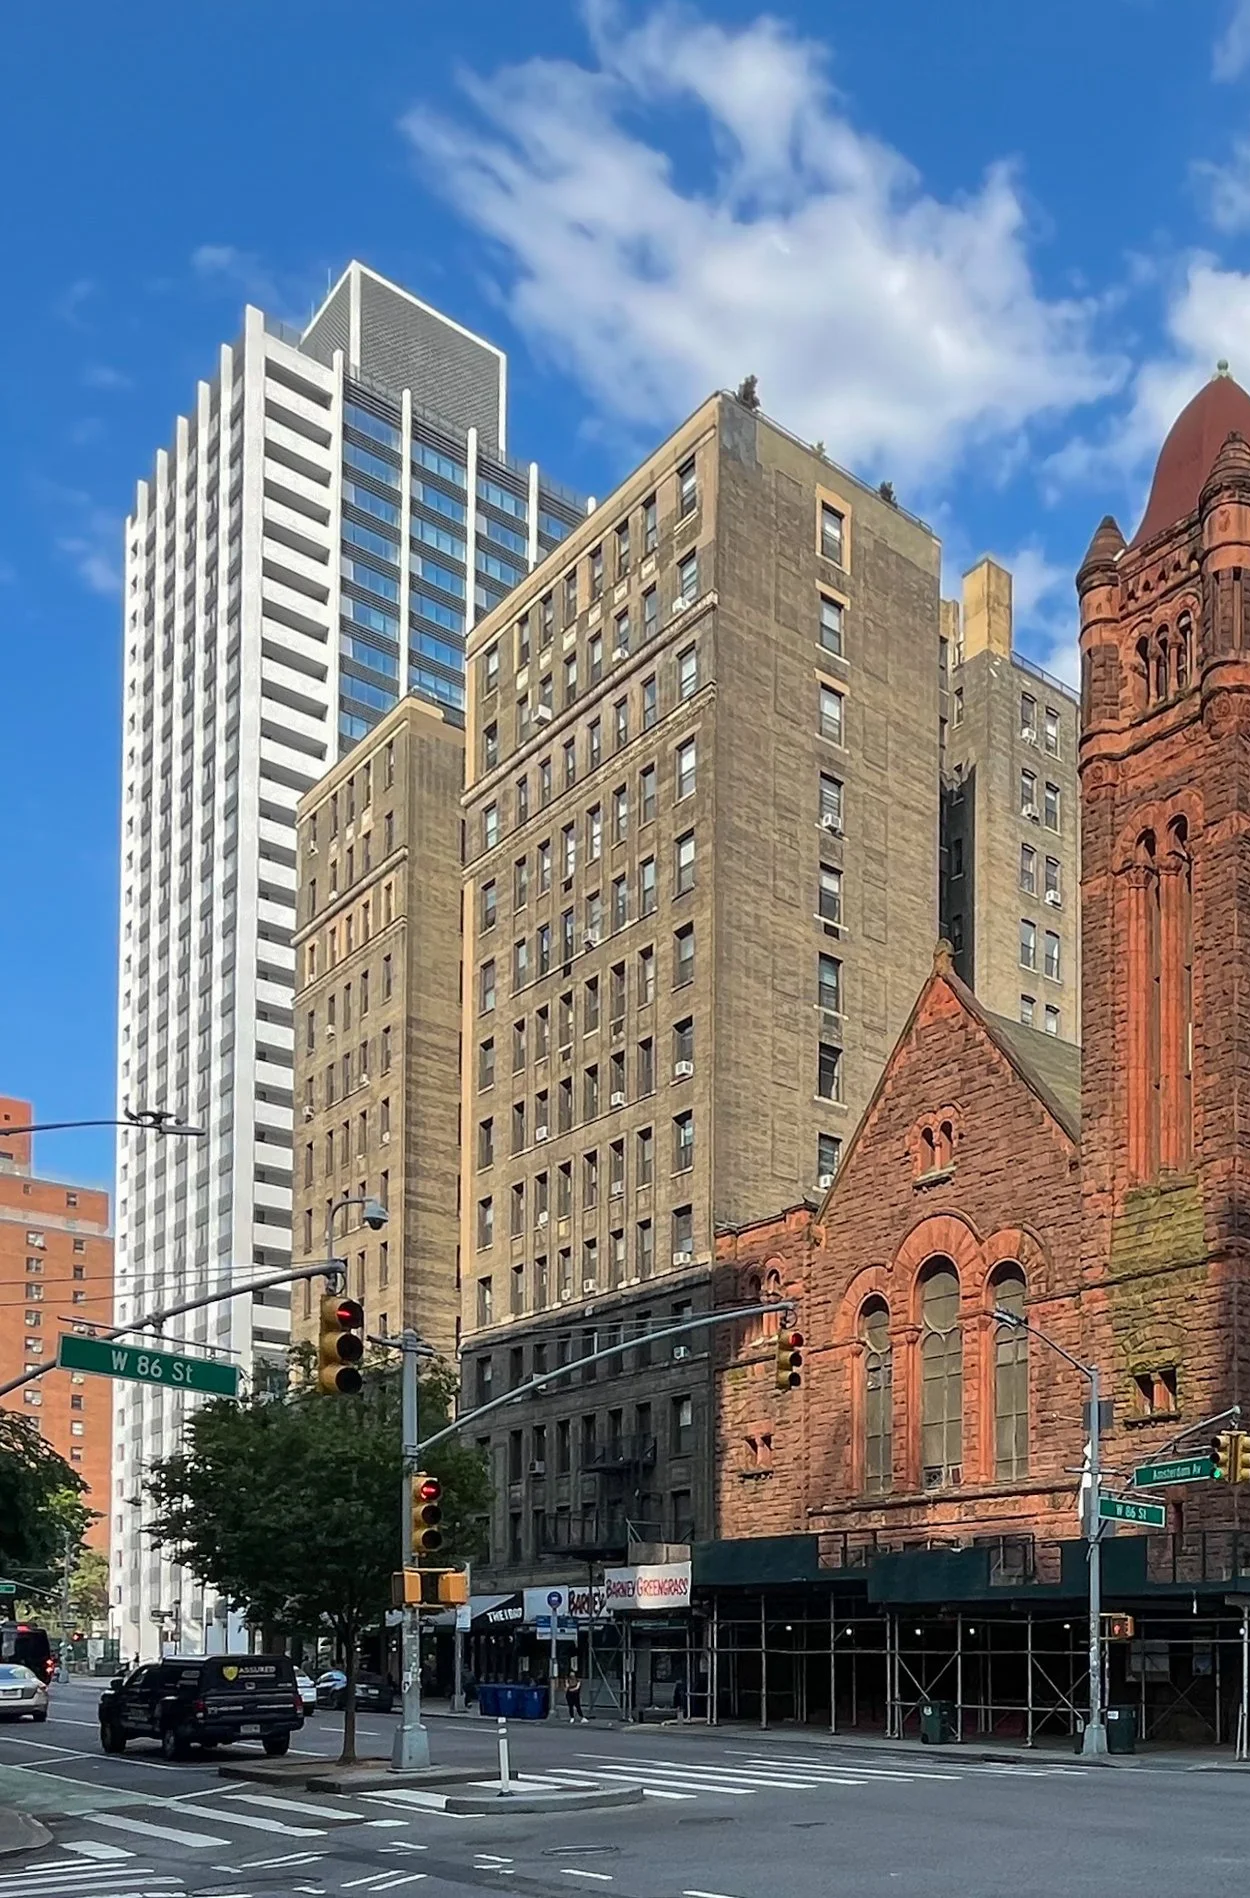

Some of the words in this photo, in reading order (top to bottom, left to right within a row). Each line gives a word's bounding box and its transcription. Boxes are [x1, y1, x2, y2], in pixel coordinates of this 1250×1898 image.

[111, 1349, 129, 1372] W
[136, 1355, 163, 1379] 86
[172, 1361, 194, 1383] St
[1153, 1466, 1191, 1480] Amsterdam
[1192, 1463, 1202, 1475] Av
[1115, 1504, 1123, 1516] W
[1125, 1505, 1136, 1519] 86
[1138, 1507, 1147, 1520] St
[606, 1578, 636, 1599] BARNEY
[636, 1576, 689, 1596] GREENGRASS
[238, 1665, 276, 1674] ASSURED
